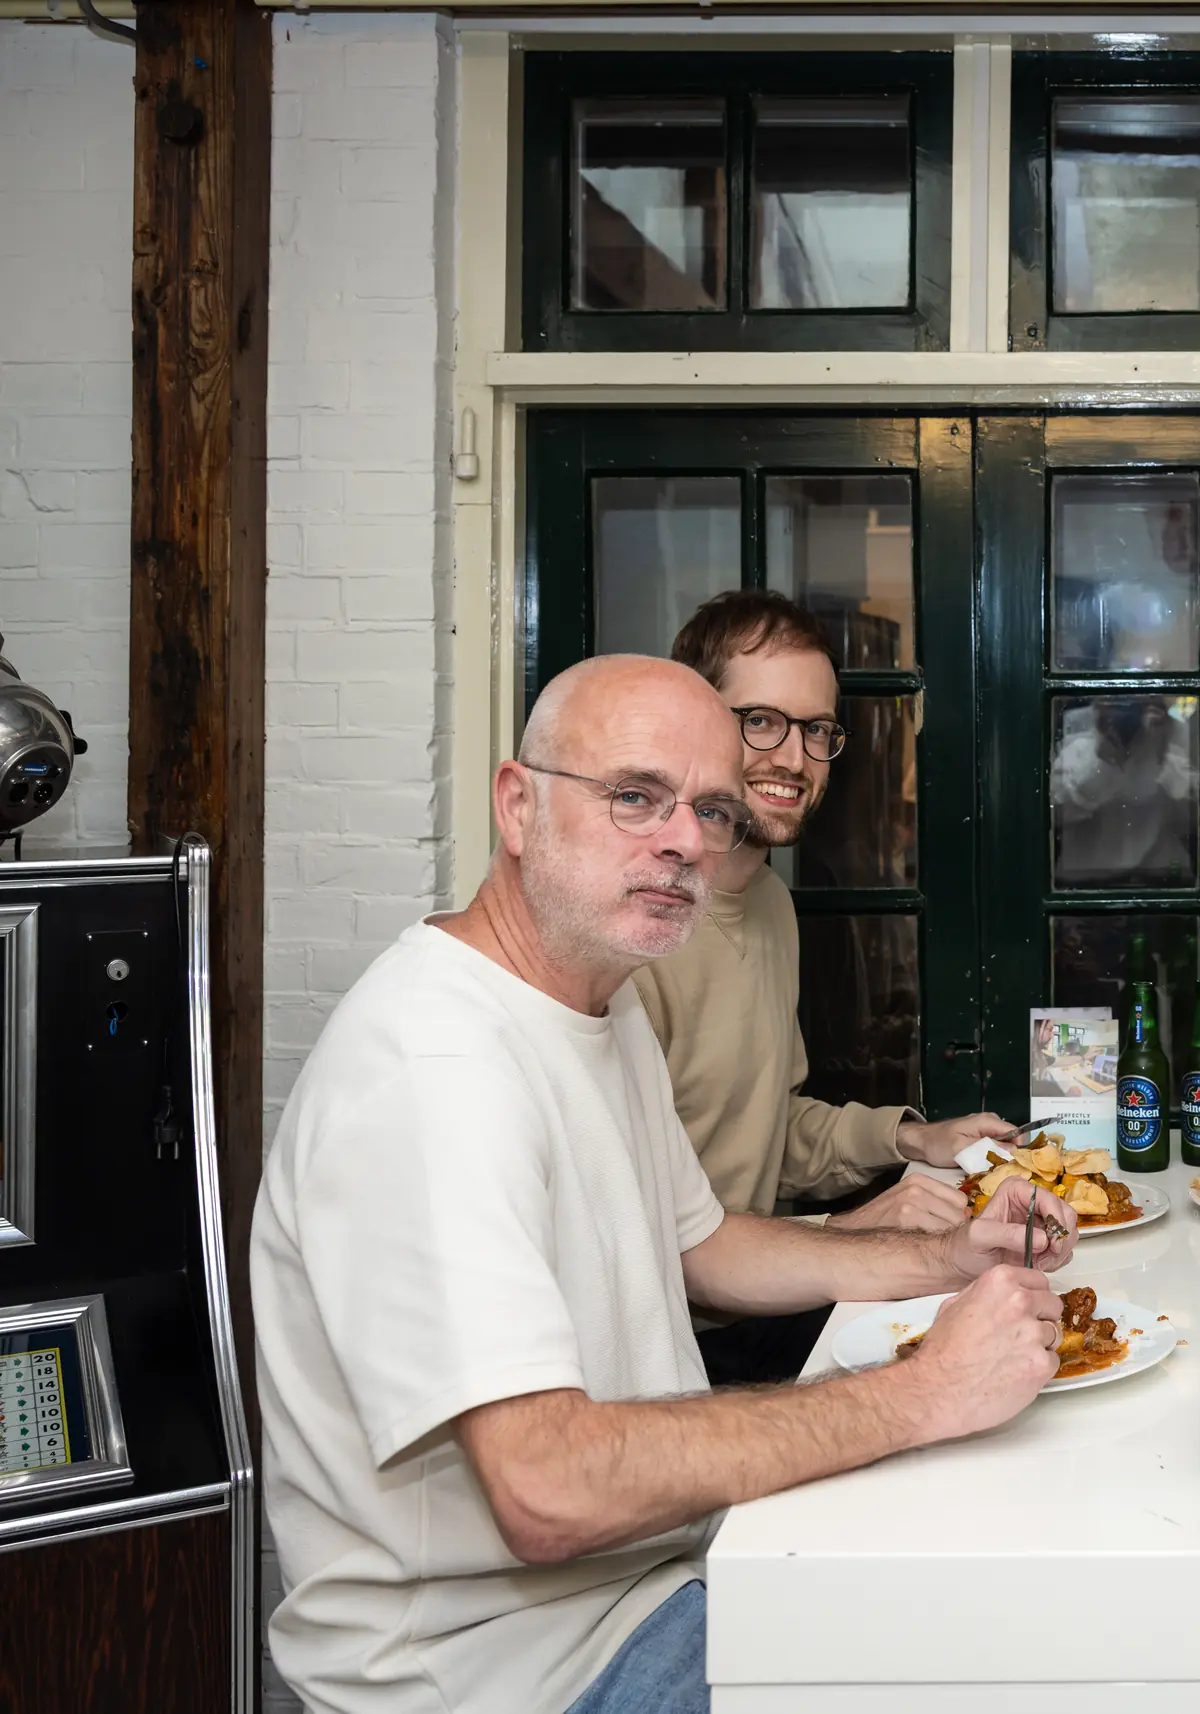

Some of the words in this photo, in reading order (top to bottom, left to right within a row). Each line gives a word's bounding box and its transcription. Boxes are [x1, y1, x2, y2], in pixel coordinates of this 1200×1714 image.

[1117, 1106, 1160, 1118] Heineken
[33, 1353, 55, 1363] 20
[37, 1366, 53, 1376] 18
[39, 1380, 55, 1390] 14
[40, 1394, 57, 1403] 10
[41, 1408, 59, 1418] 10
[43, 1422, 60, 1432] 10
[47, 1437, 57, 1446] 6
